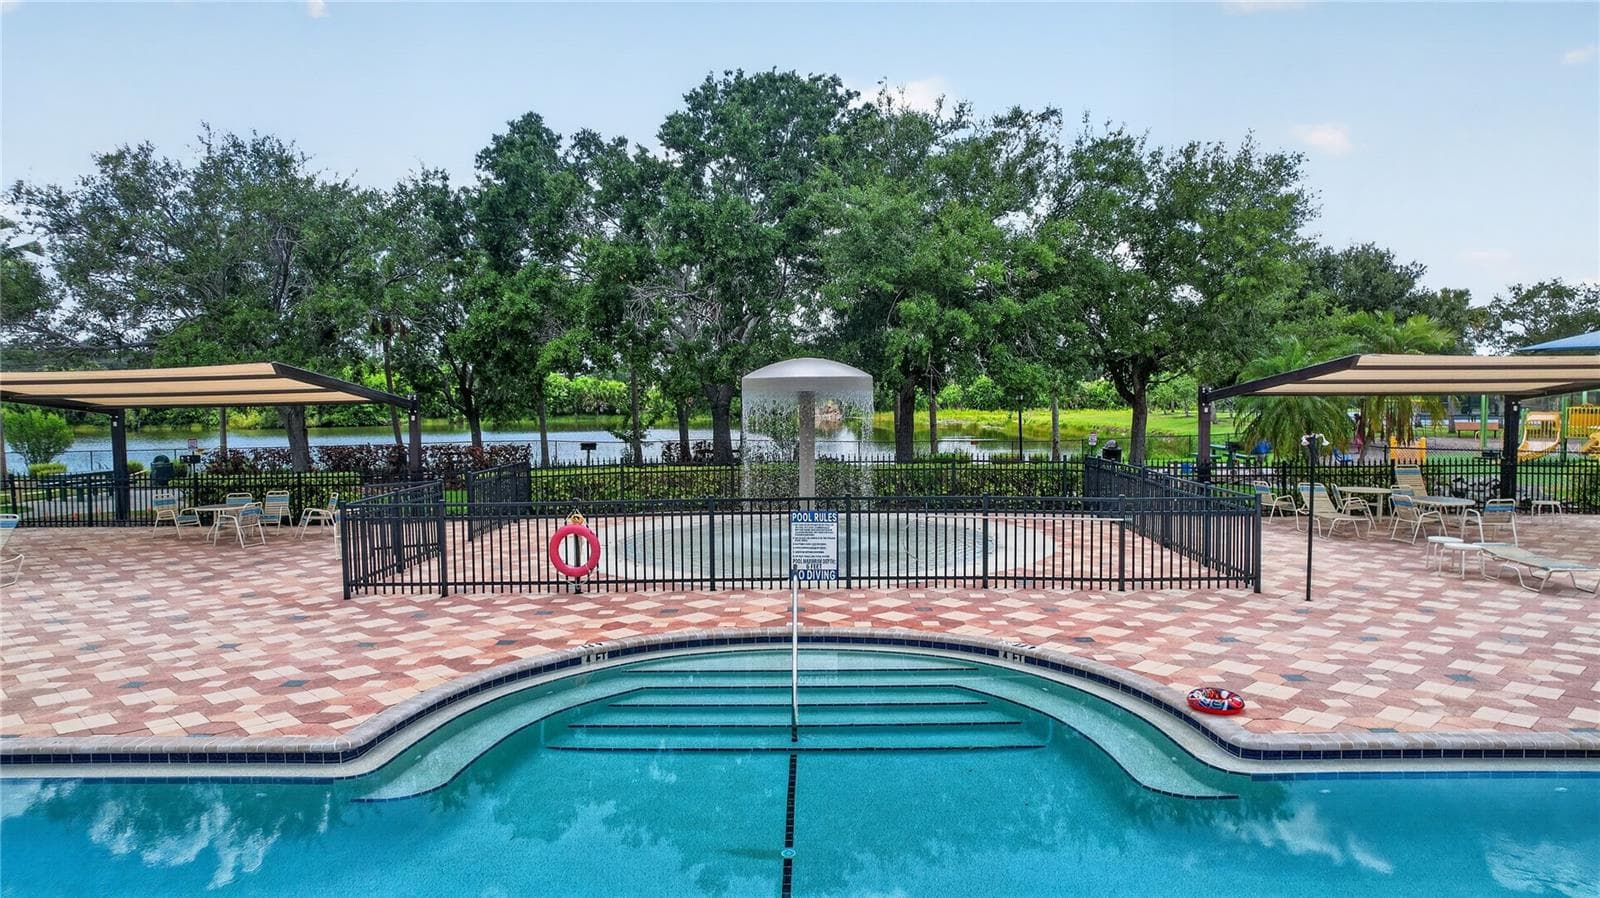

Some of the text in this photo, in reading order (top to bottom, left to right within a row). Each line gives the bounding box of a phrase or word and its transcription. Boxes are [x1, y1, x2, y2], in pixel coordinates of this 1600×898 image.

[792, 512, 837, 522] POOL RULES
[806, 570, 836, 580] DIVING
[595, 651, 606, 661] FT
[1012, 652, 1023, 662] FT
